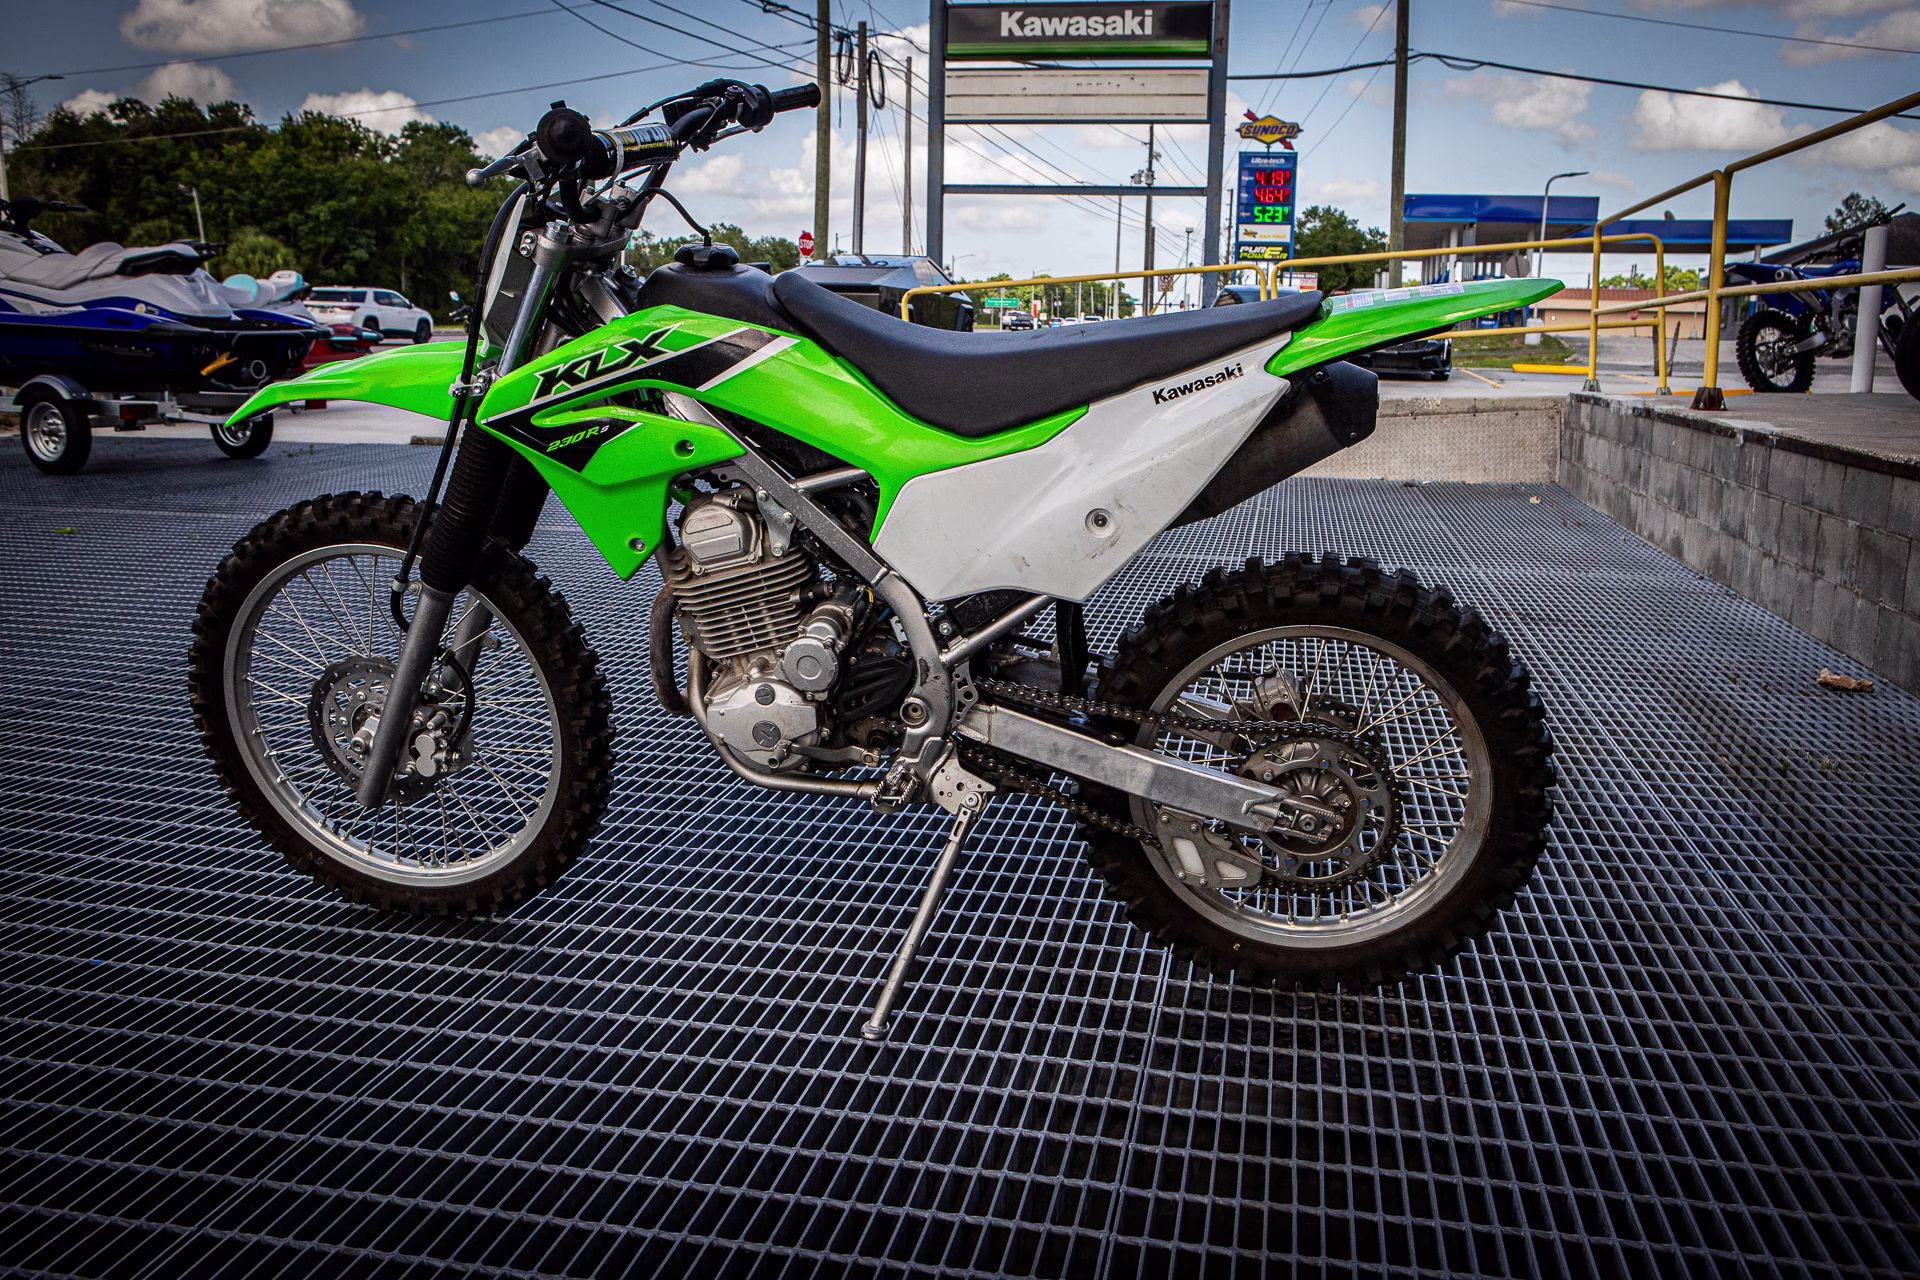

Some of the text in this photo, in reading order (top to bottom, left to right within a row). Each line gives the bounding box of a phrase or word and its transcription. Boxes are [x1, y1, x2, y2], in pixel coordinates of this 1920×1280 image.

[1001, 9, 1153, 37] Kawasaki
[1243, 125, 1297, 135] SUNOCO
[800, 239, 815, 249] STOP
[529, 322, 684, 405] KLX
[1152, 363, 1244, 405] Kawasaki
